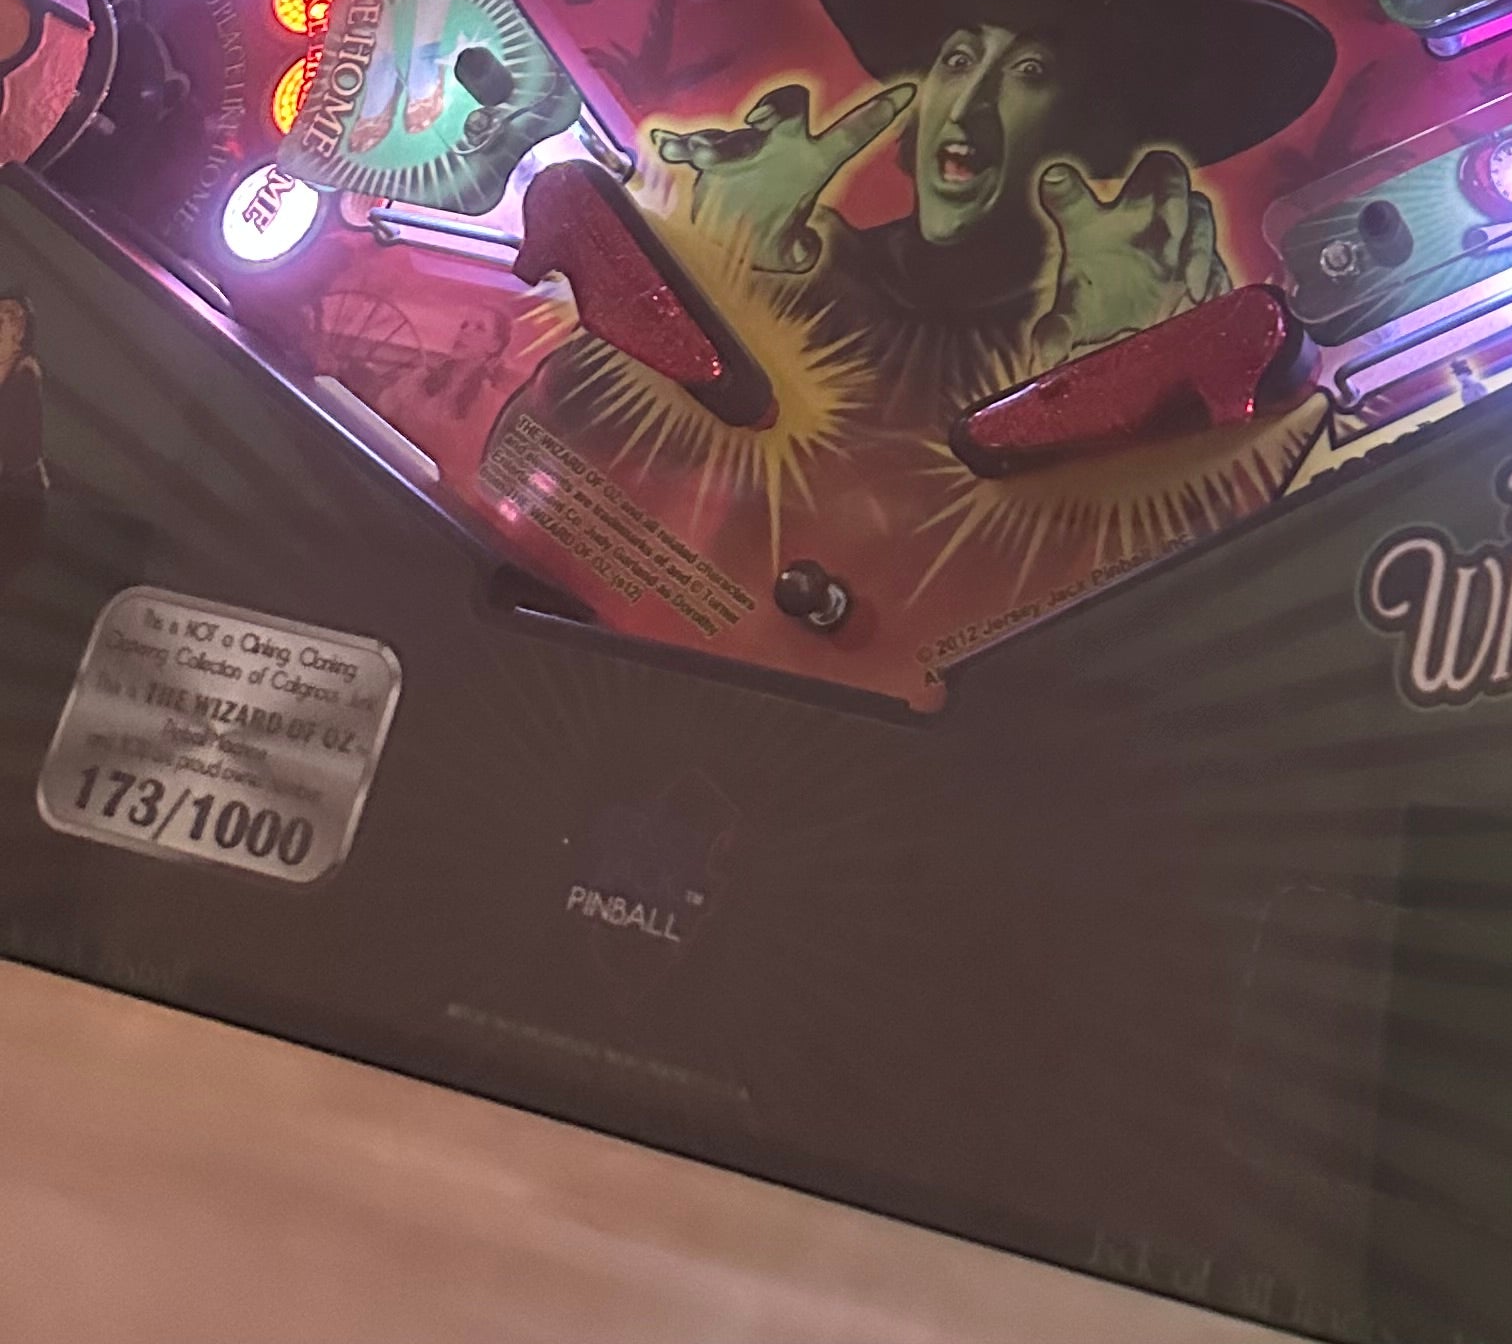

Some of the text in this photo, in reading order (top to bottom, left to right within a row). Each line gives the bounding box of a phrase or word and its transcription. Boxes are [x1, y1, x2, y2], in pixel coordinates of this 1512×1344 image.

[300, 30, 376, 160] HOME
[519, 416, 545, 442] THE
[540, 434, 587, 476] WIZARD
[585, 469, 605, 489] OF
[74, 765, 315, 866] 173/1000
[566, 885, 681, 943] PINBALL
